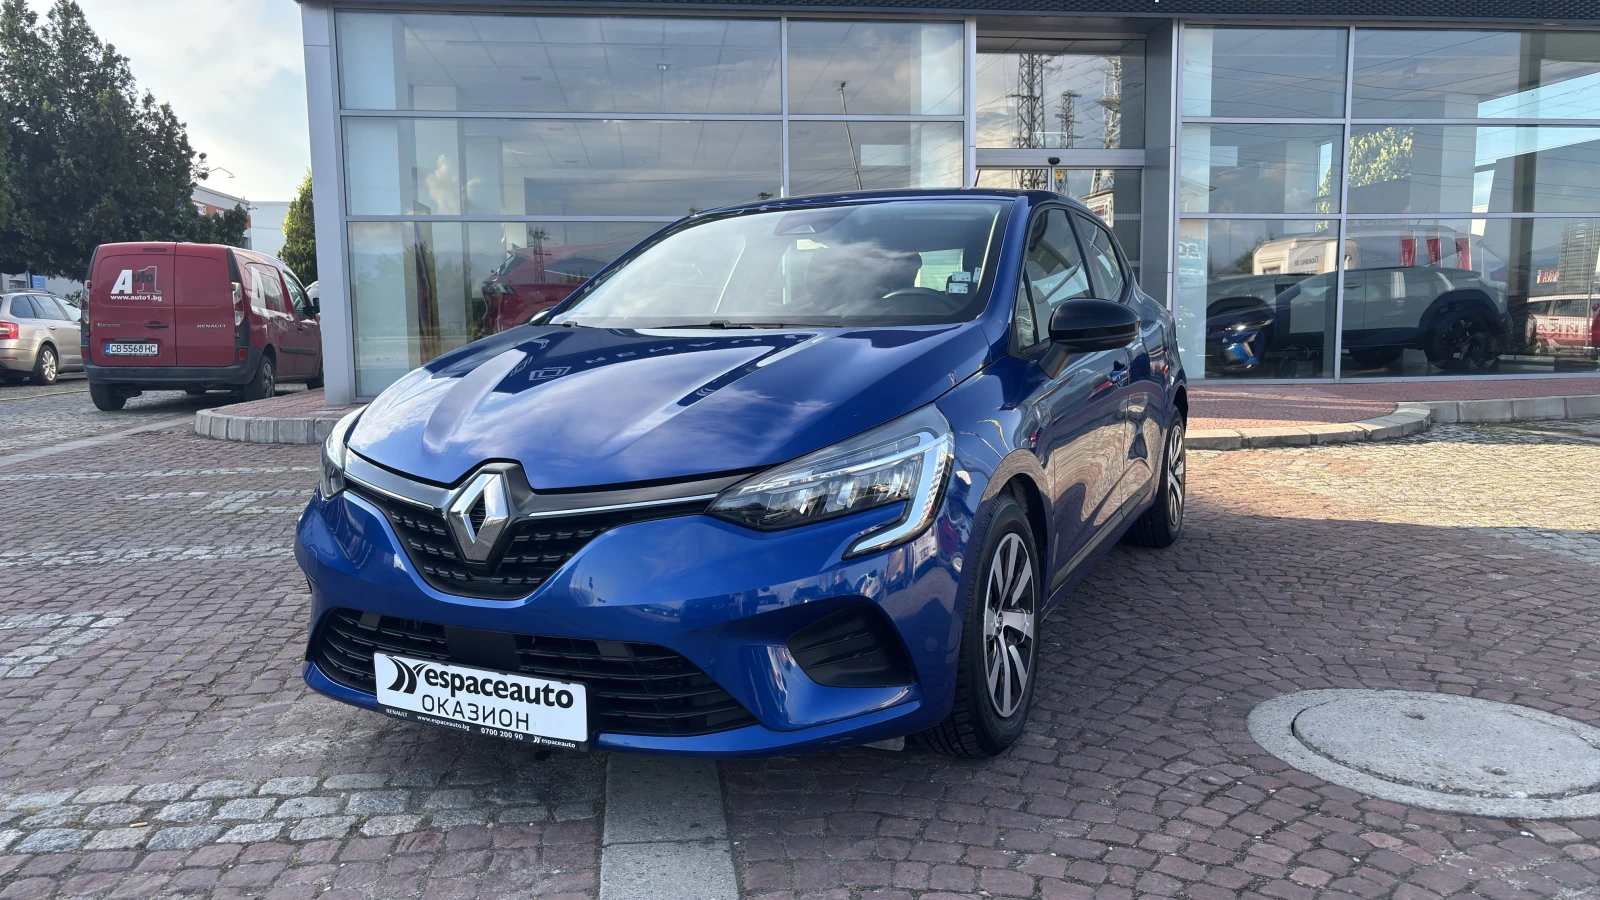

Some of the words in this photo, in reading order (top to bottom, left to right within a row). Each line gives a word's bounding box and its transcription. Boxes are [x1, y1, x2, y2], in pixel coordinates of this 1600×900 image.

[110, 294, 163, 302] www.auto1.bg
[110, 344, 122, 353] CB
[123, 344, 144, 353] 5568
[144, 344, 156, 353] HC
[424, 667, 575, 709] espaceauto
[385, 707, 408, 718] RENAULT
[416, 714, 471, 732] www.espaceauto.bg
[480, 727, 498, 737] 0700
[499, 730, 513, 739] 200
[514, 732, 524, 741] 90
[540, 737, 576, 749] espaceauto
[421, 694, 529, 731] ОКАЗИОН
